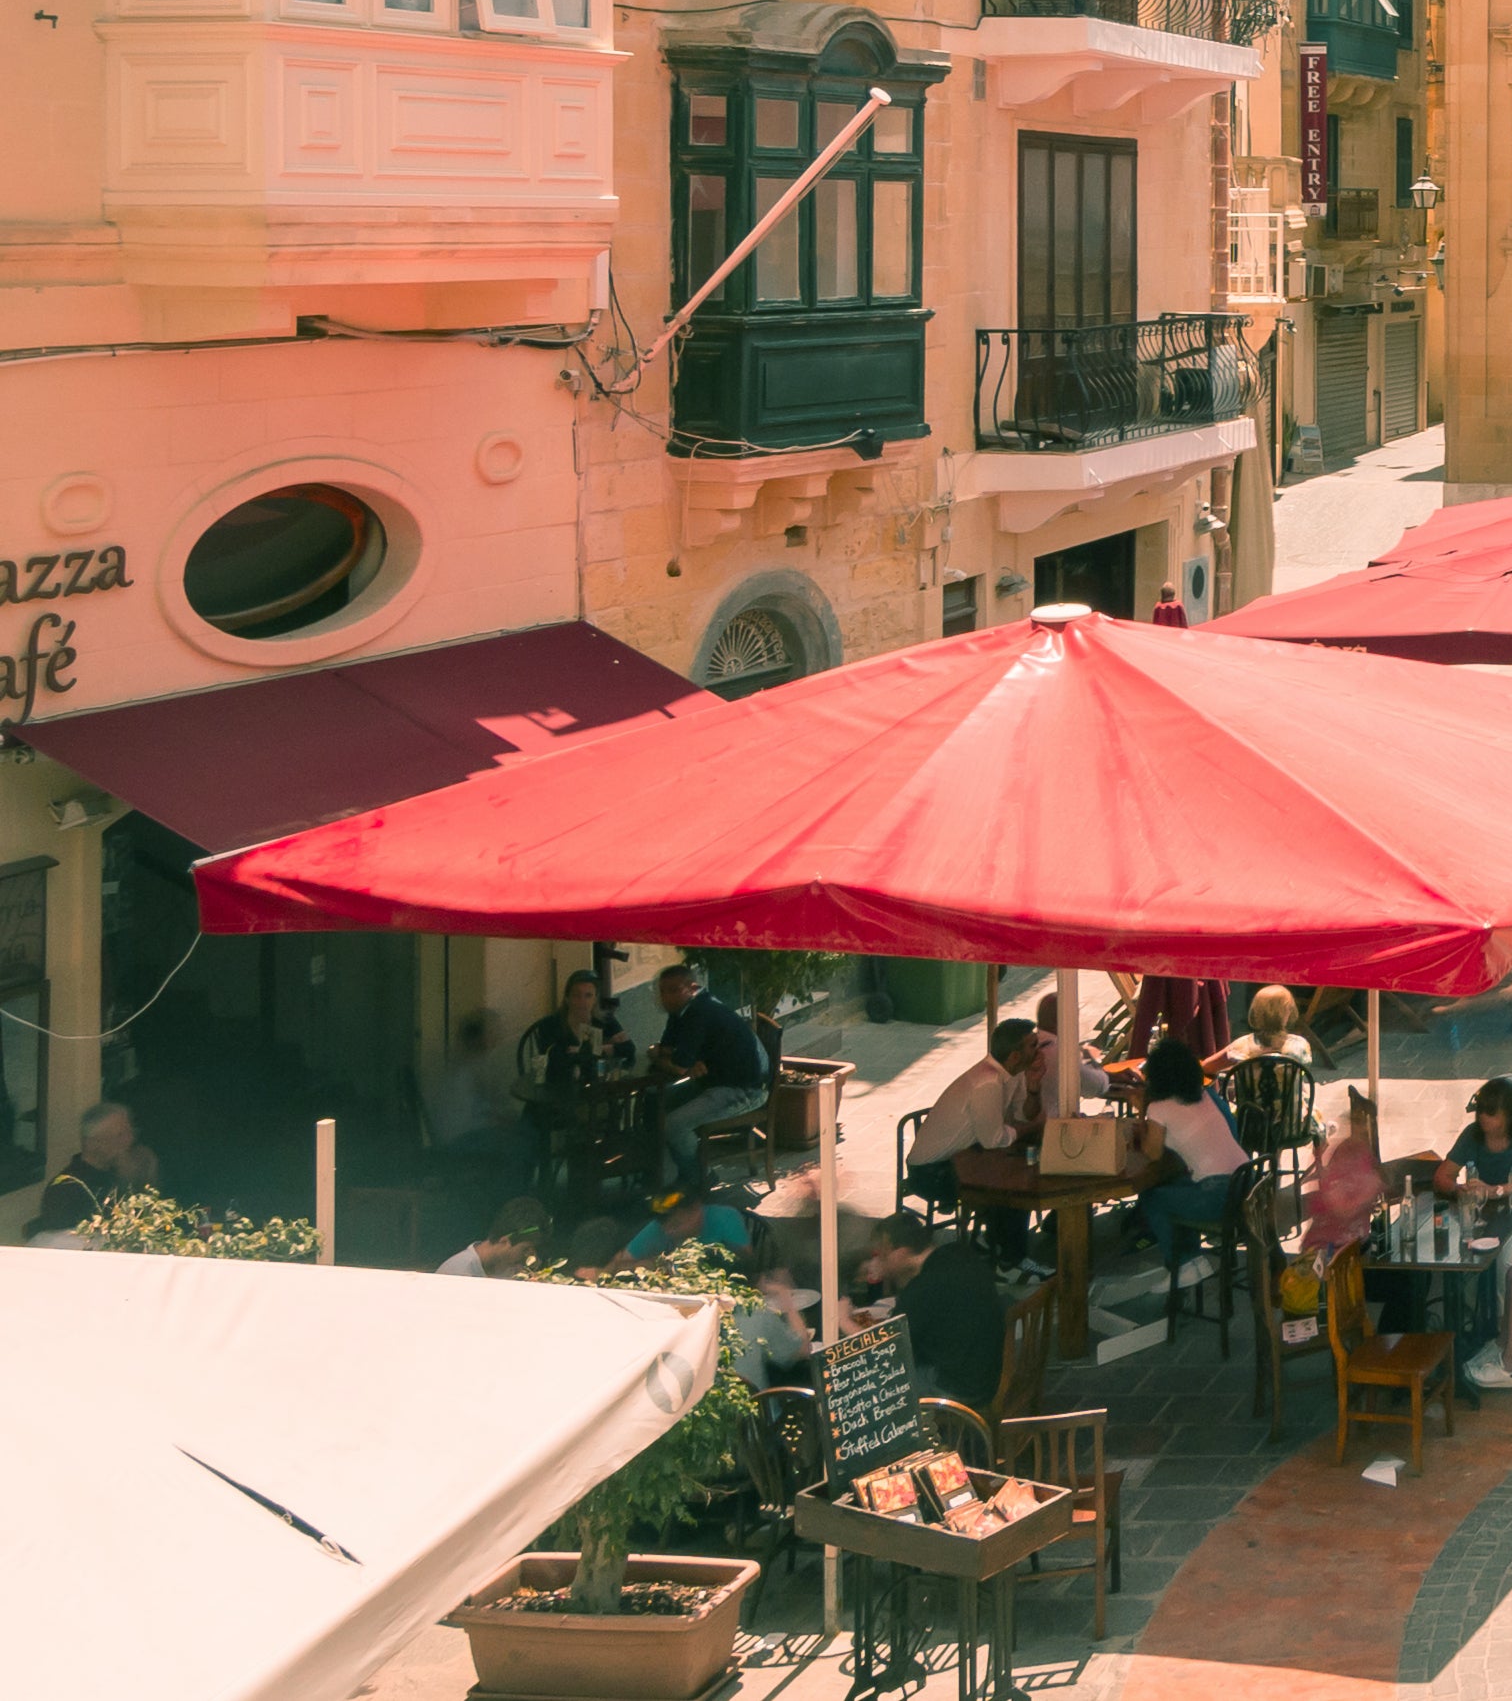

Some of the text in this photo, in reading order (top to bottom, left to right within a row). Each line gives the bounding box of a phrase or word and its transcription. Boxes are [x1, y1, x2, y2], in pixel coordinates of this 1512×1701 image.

[1307, 56, 1321, 113] FREE
[1307, 128, 1321, 201] ENTRY
[825, 1326, 893, 1364] SPECIALS:
[842, 1413, 869, 1435] Duck
